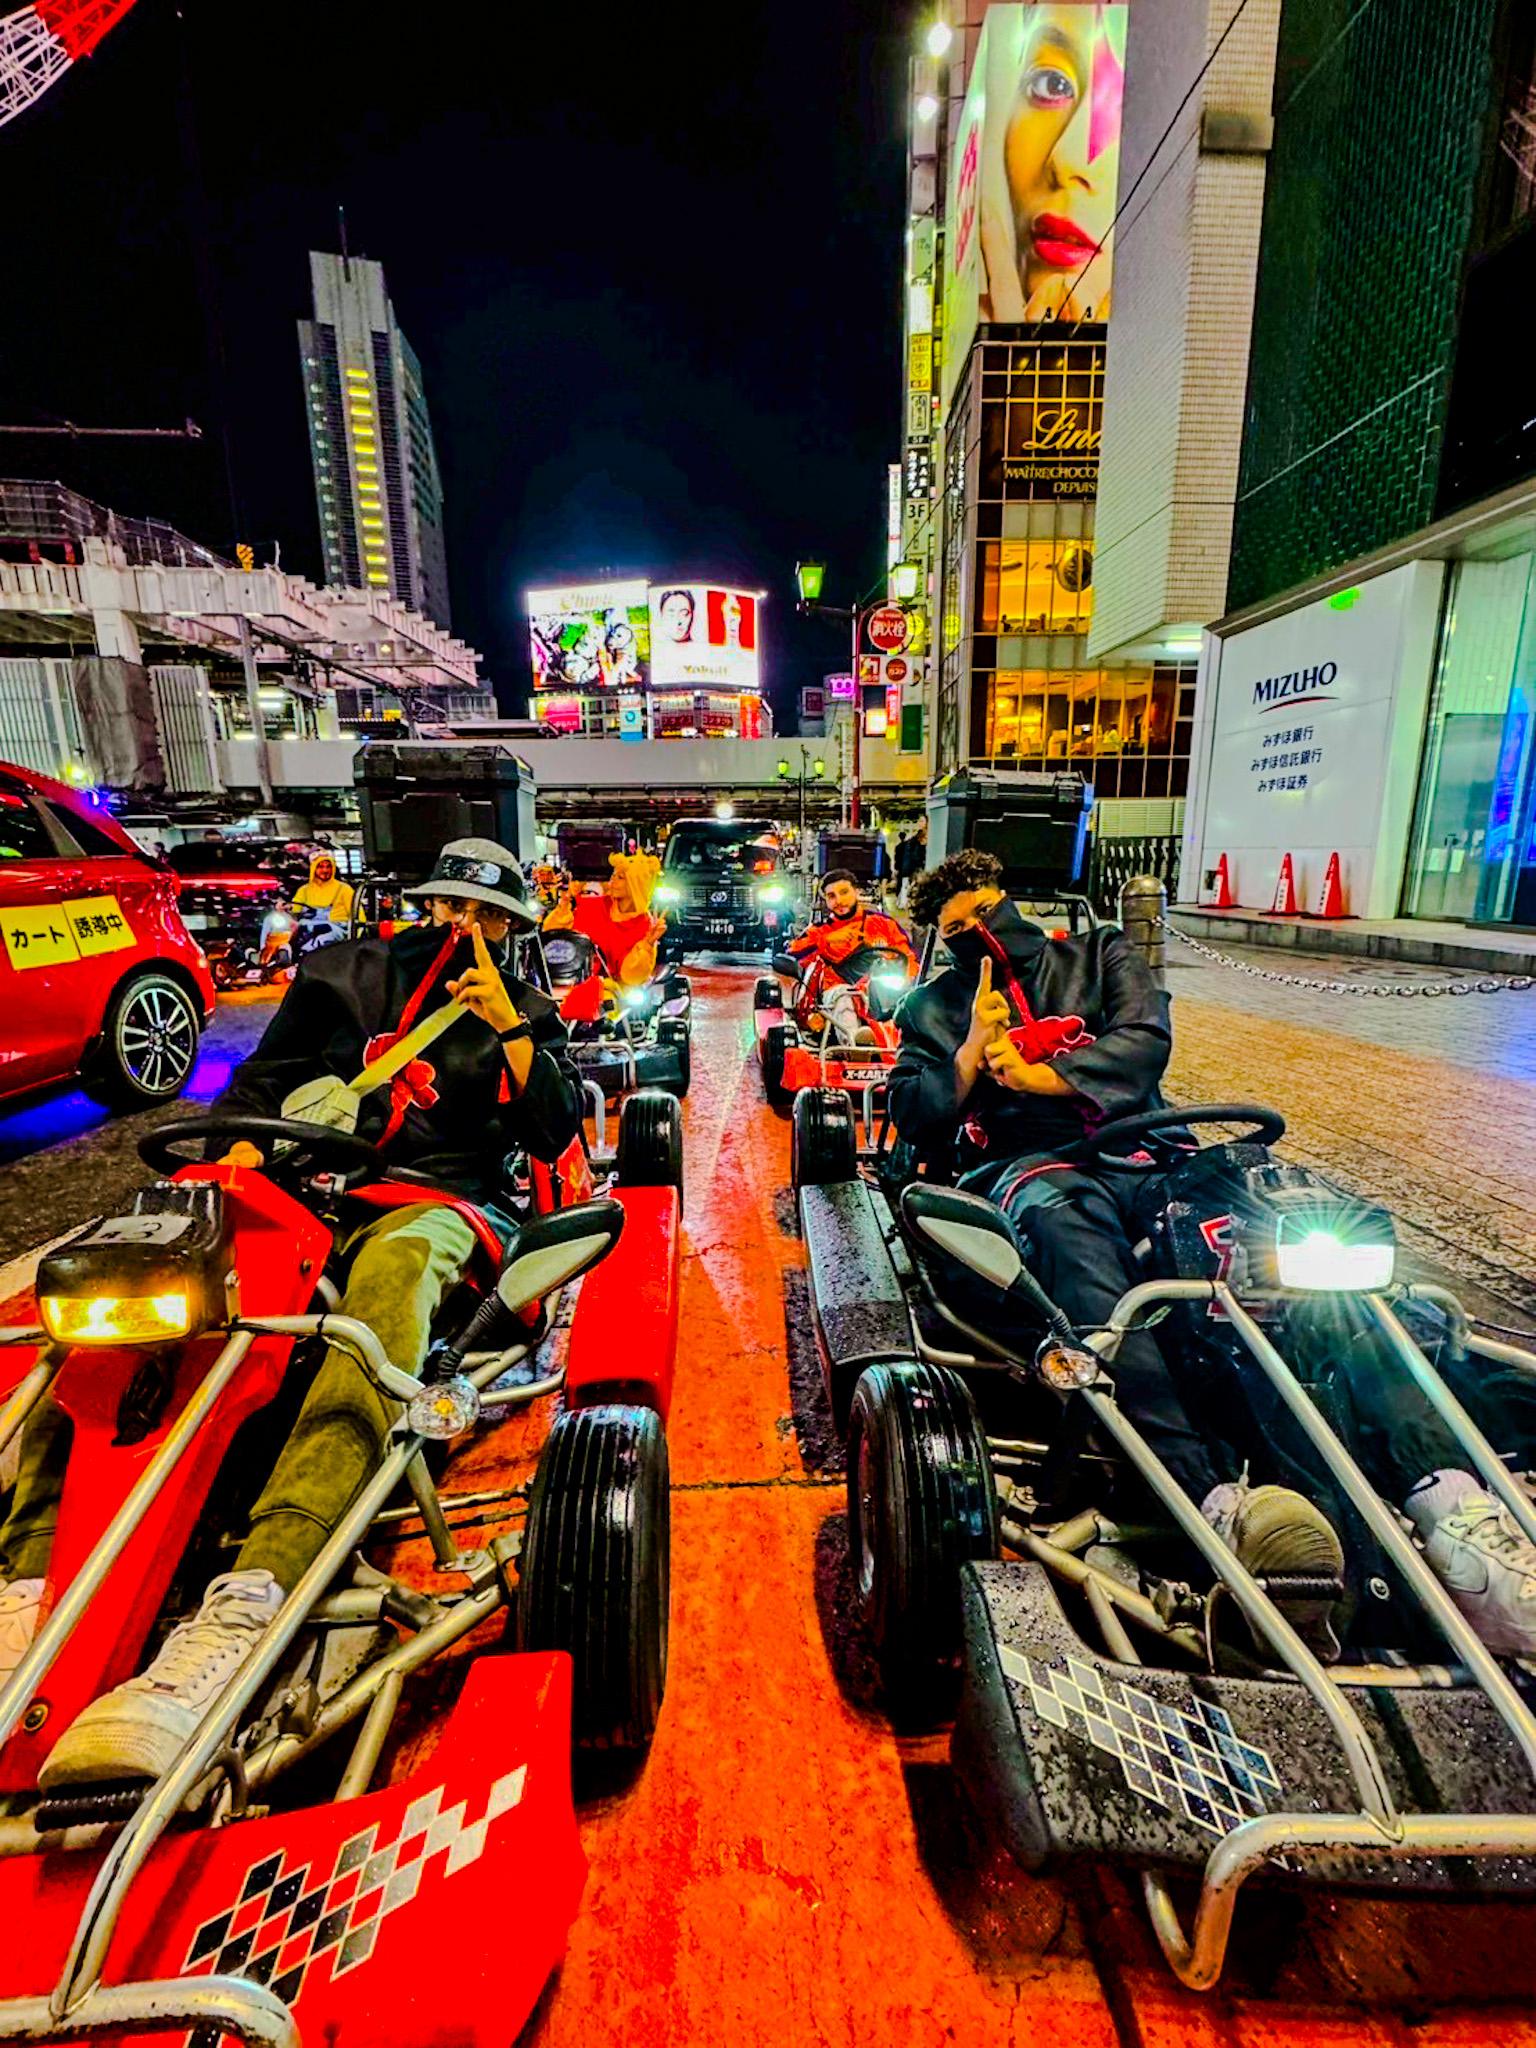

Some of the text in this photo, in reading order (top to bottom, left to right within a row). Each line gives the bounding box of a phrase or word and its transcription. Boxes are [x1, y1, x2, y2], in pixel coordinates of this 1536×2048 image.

[1050, 466, 1098, 479] CHOCO
[1053, 481, 1096, 494] DEPUIS
[908, 504, 925, 519] 3F
[873, 619, 905, 638] 消火栓
[1253, 661, 1337, 704] MIZUHO
[1262, 725, 1314, 748] みずほ銀行
[1250, 748, 1322, 771] みずほ信託銀行
[1257, 774, 1308, 793] みずほ証券
[11, 913, 123, 949] カート 誘導中
